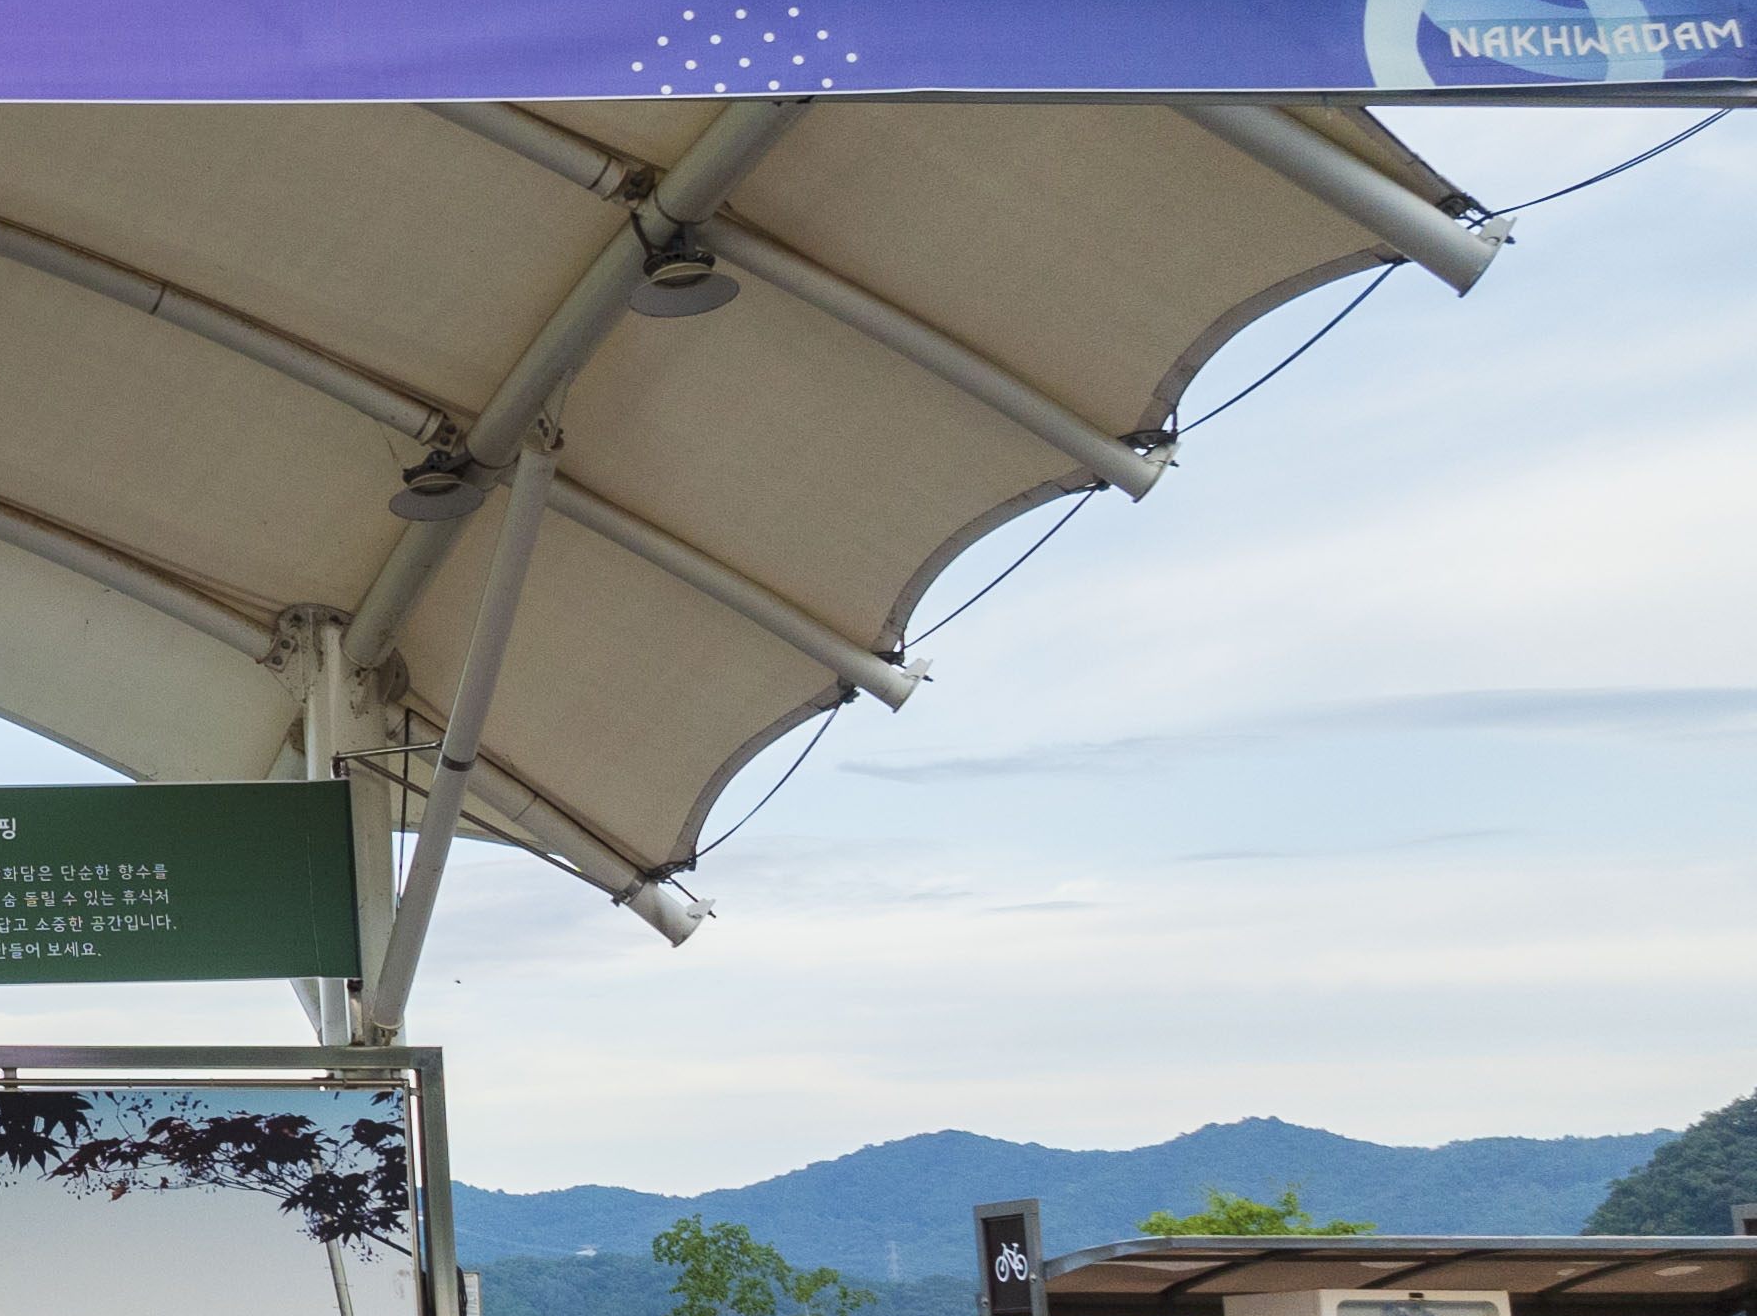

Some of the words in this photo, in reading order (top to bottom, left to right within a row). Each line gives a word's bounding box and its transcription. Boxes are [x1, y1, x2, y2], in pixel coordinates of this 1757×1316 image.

[1449, 19, 1742, 58] NAKHWADAM
[60, 864, 110, 882] 단순한
[118, 863, 168, 880] 향수를
[2, 891, 17, 908] 숨
[23, 890, 55, 908] 돌릴
[62, 891, 78, 906] 수
[83, 889, 115, 906] 있는
[122, 888, 169, 905] 휴식처
[35, 915, 84, 933] 소중한
[90, 913, 177, 932] 공간입니다.
[46, 941, 102, 958] 보세요.
